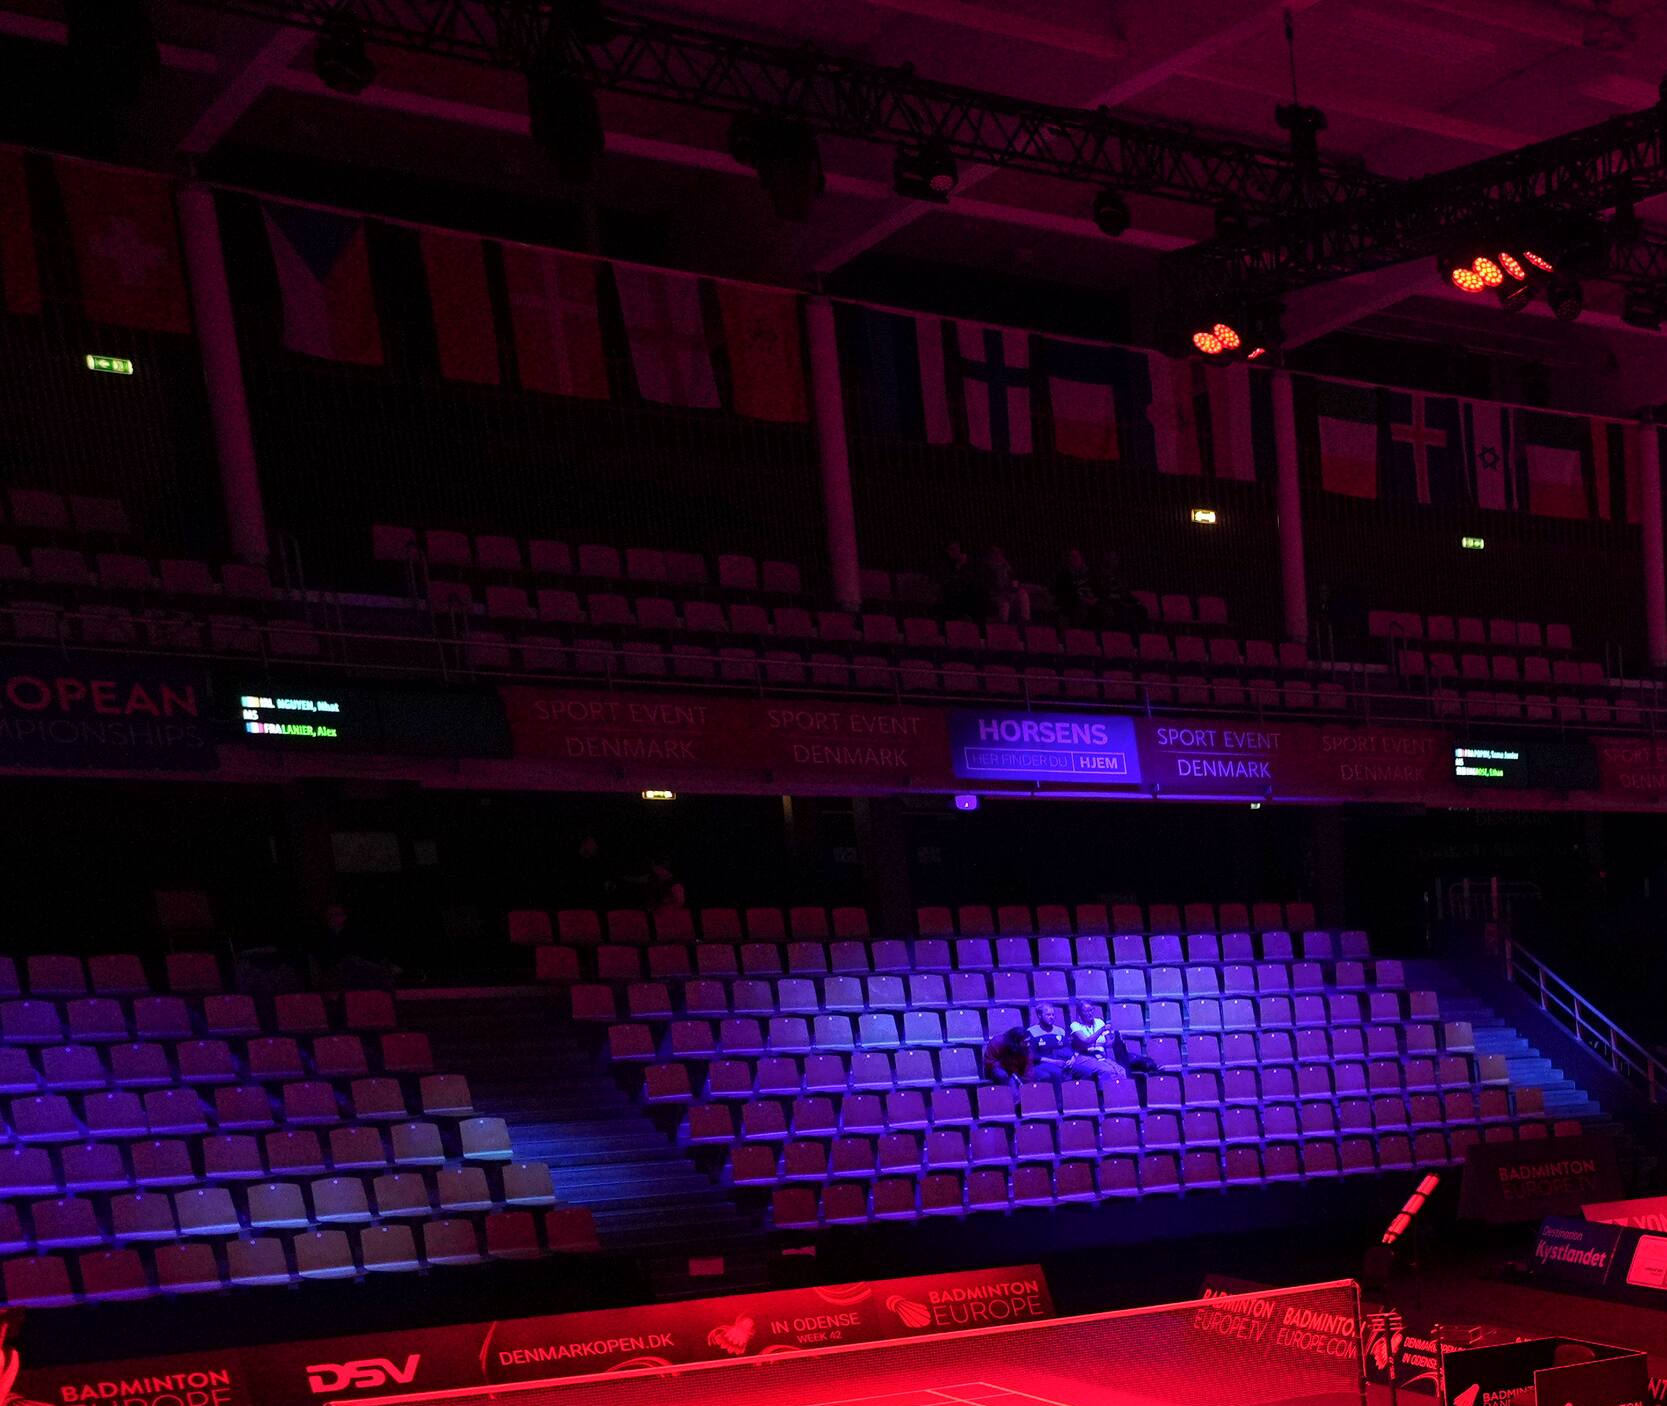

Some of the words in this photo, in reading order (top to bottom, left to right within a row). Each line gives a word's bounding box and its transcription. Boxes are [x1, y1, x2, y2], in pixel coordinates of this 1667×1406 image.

[534, 701, 620, 721] SPORT
[630, 703, 709, 725] EVENT
[767, 709, 840, 731] SPORT
[851, 714, 920, 736] EVENT
[977, 719, 1108, 745] HORSENS
[1157, 728, 1216, 748] SPORT
[1224, 732, 1280, 752] EVENT
[566, 736, 696, 760] DENMARK
[793, 743, 908, 768] DENMARK
[1321, 734, 1376, 754] SPORT
[1382, 736, 1434, 756] EVENT
[1079, 755, 1119, 770] HJEM
[1177, 758, 1271, 779] DENMARK
[1340, 763, 1425, 784] DENMARK
[1498, 1159, 1597, 1182] BADMINTON
[1541, 1225, 1584, 1241] Destination
[1535, 1241, 1608, 1269] Kystlandet
[929, 1279, 1040, 1306] BADMINTON
[770, 1319, 790, 1334] IN
[793, 1310, 861, 1332] ODENSE
[934, 1296, 1045, 1328] EUROPE
[1193, 1307, 1268, 1343] EUROPE.TV
[499, 1331, 675, 1367] DENMARKOPEN.DK
[797, 1330, 829, 1346] WEEK
[830, 1329, 843, 1343] 42
[61, 1368, 231, 1403] BADMINTON
[305, 1353, 422, 1394] DSV
